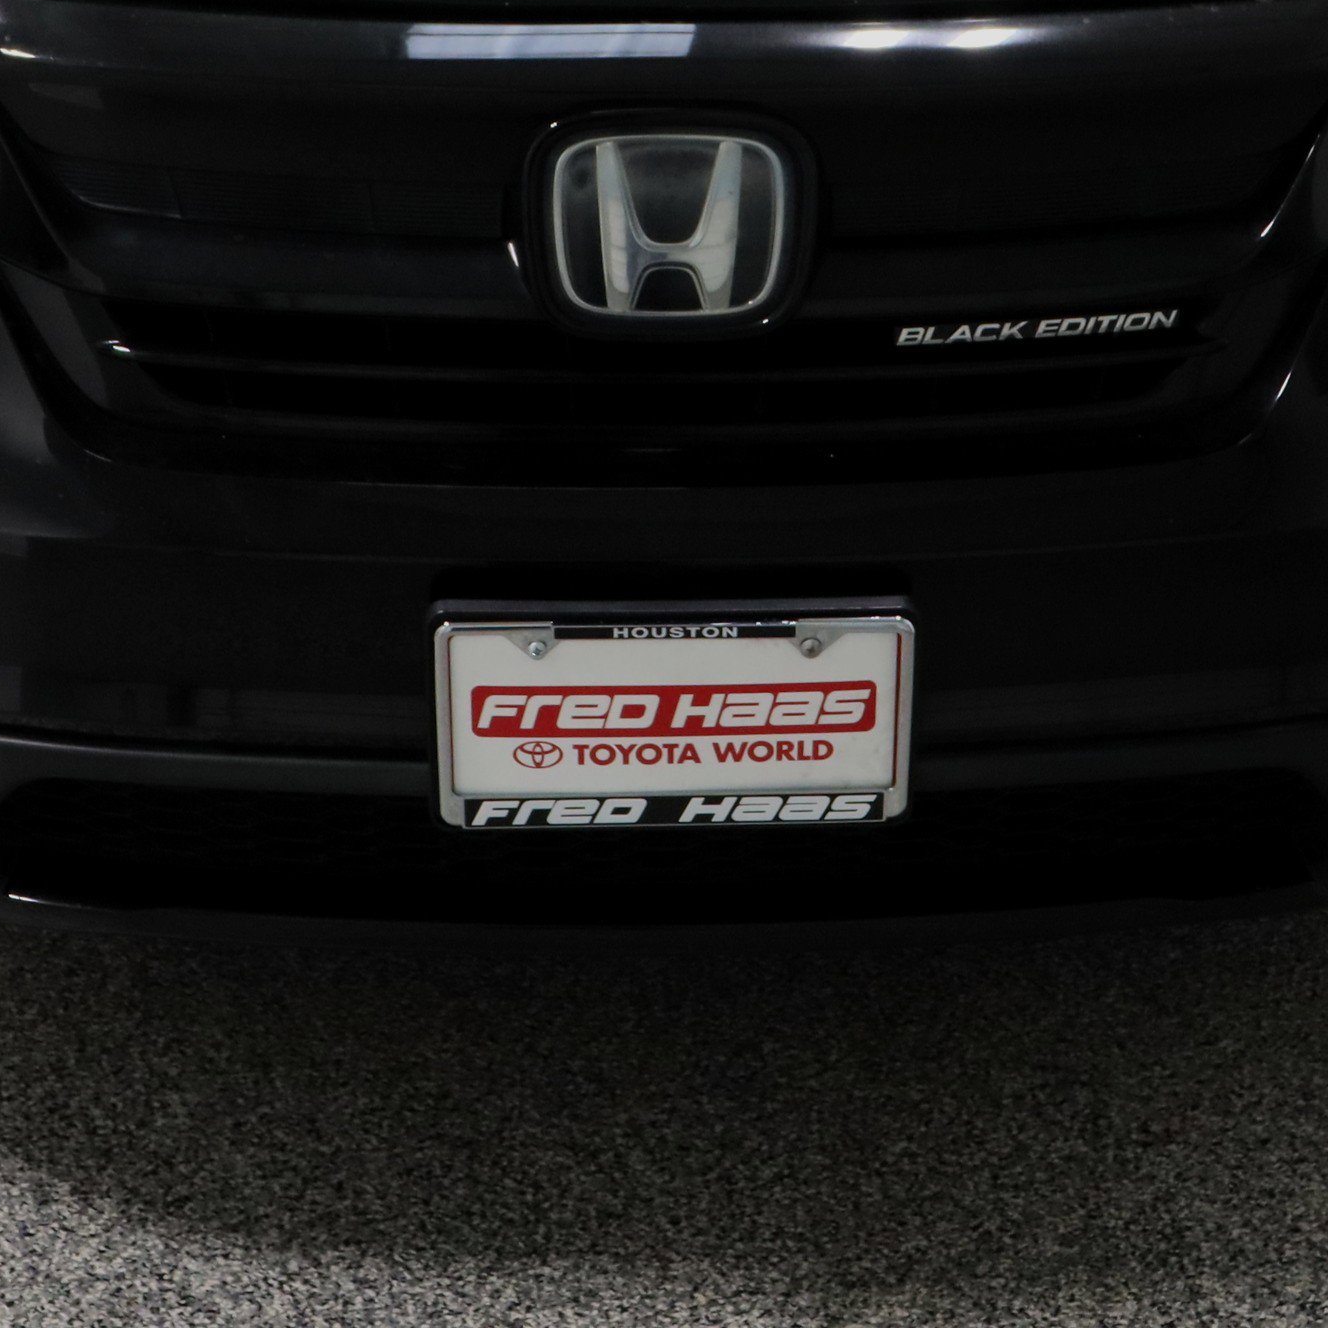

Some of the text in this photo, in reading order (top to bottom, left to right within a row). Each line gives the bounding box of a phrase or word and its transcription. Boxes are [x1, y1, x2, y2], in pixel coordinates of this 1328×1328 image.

[896, 309, 1178, 346] BLACK EDITION
[612, 626, 739, 640] HOUSTON
[573, 740, 834, 766] TOYOTA WORLD
